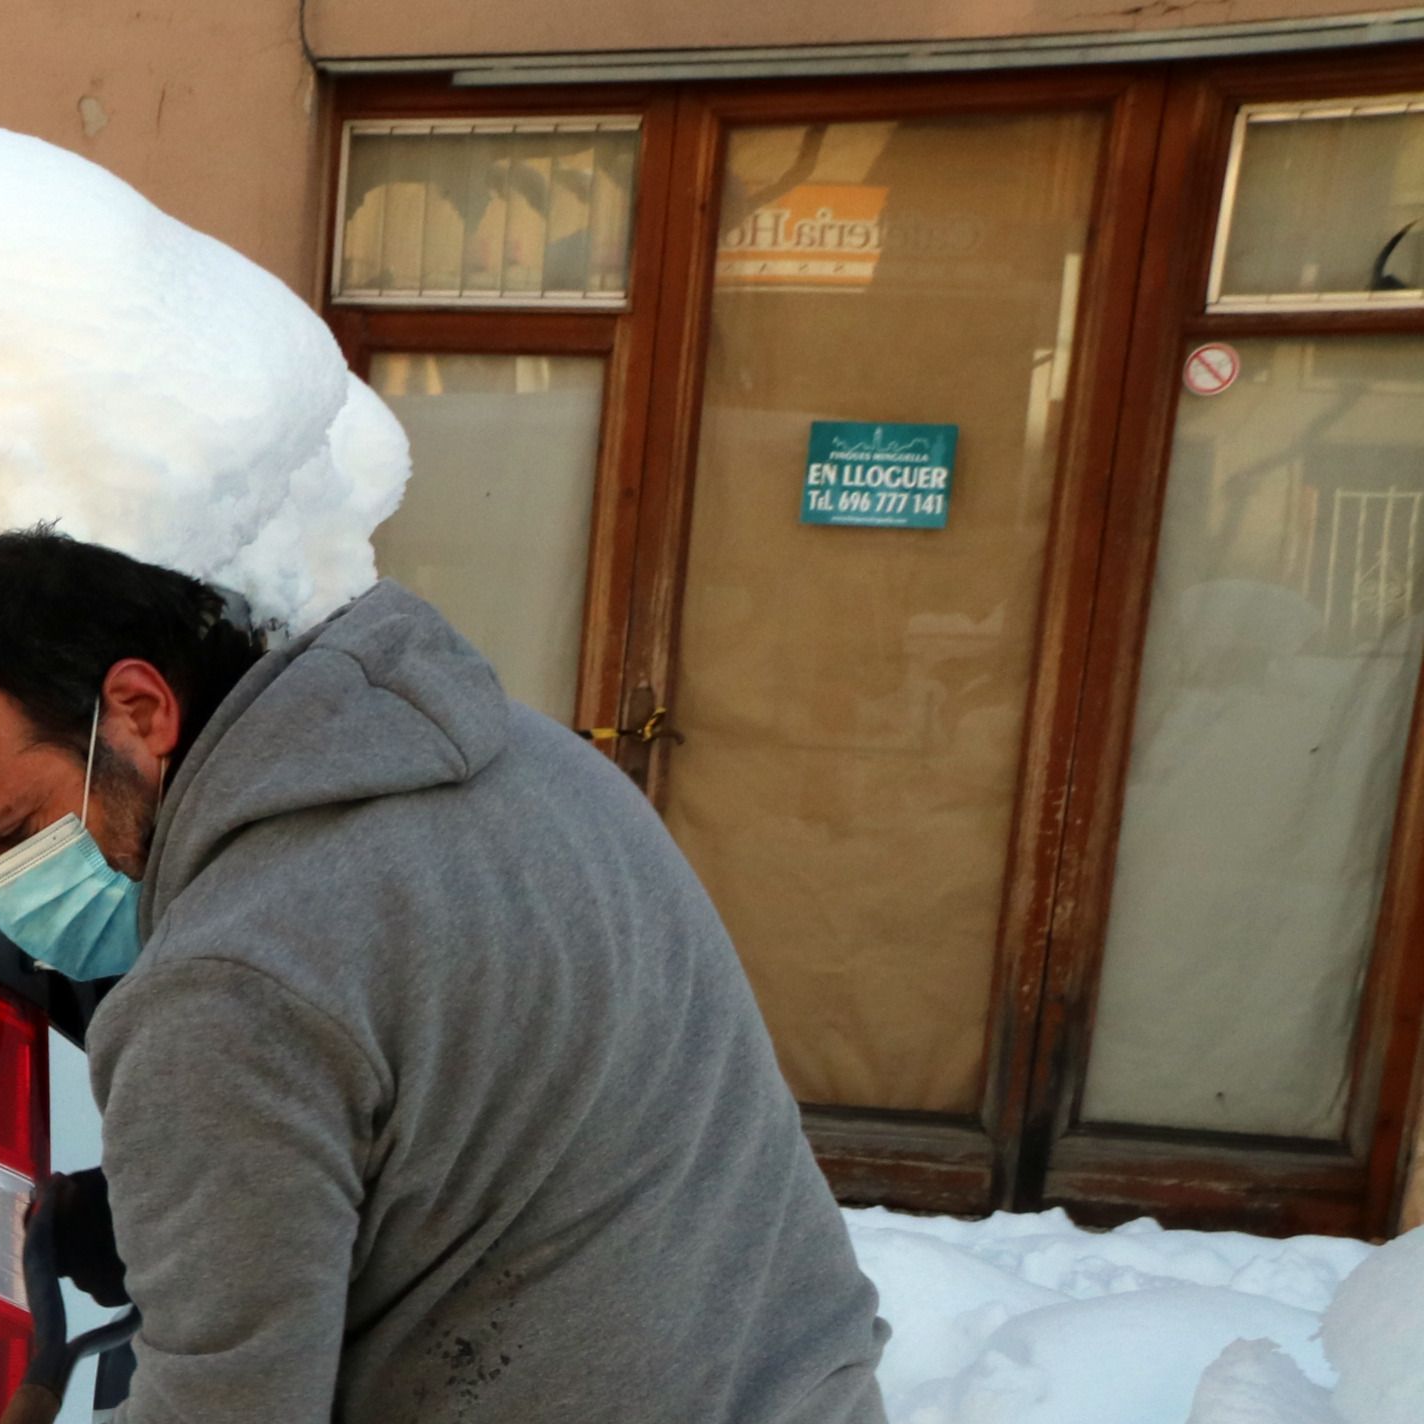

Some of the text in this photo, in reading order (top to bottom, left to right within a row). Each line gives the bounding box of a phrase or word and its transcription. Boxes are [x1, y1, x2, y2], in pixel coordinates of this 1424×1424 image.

[807, 463, 948, 488] EN LLOGUER
[838, 490, 871, 512] 696
[875, 492, 909, 513] 777
[913, 493, 944, 514] 141
